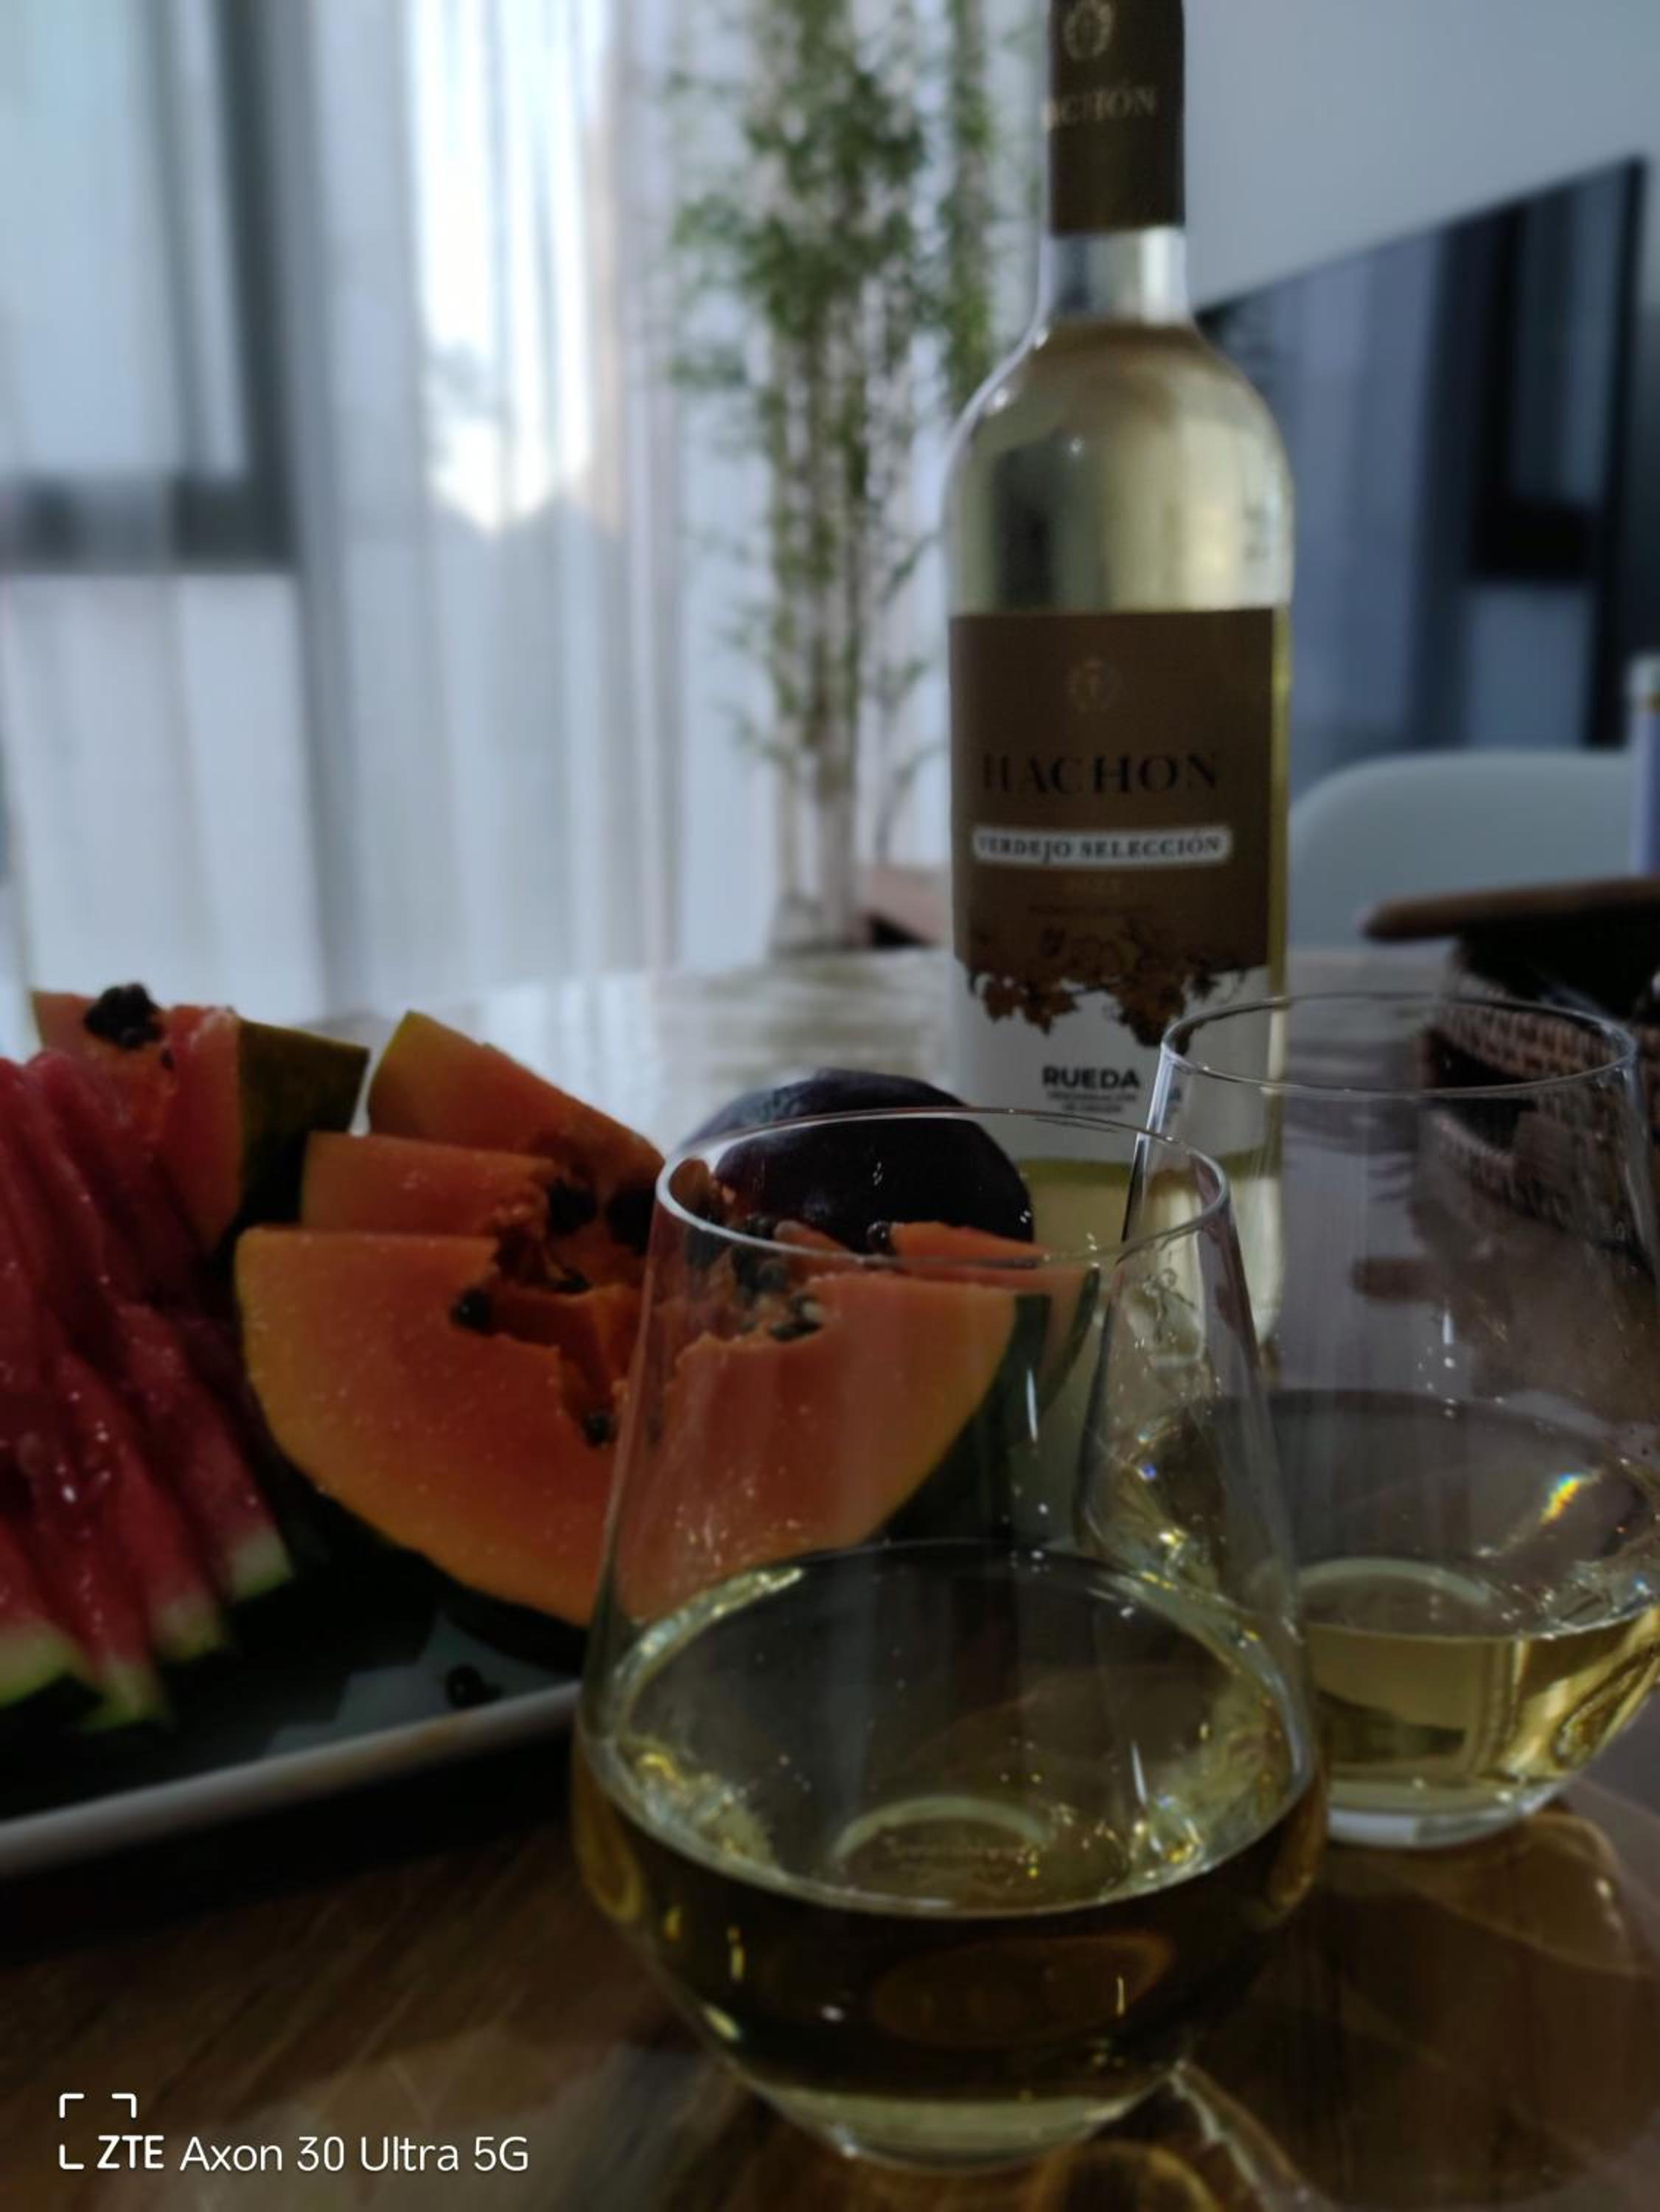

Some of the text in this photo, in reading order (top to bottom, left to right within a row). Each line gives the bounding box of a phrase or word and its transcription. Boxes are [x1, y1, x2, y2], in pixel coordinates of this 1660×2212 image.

[977, 830, 1220, 864] VERDEJO SELECCIÓN
[1043, 1065, 1140, 1089] RUEDA
